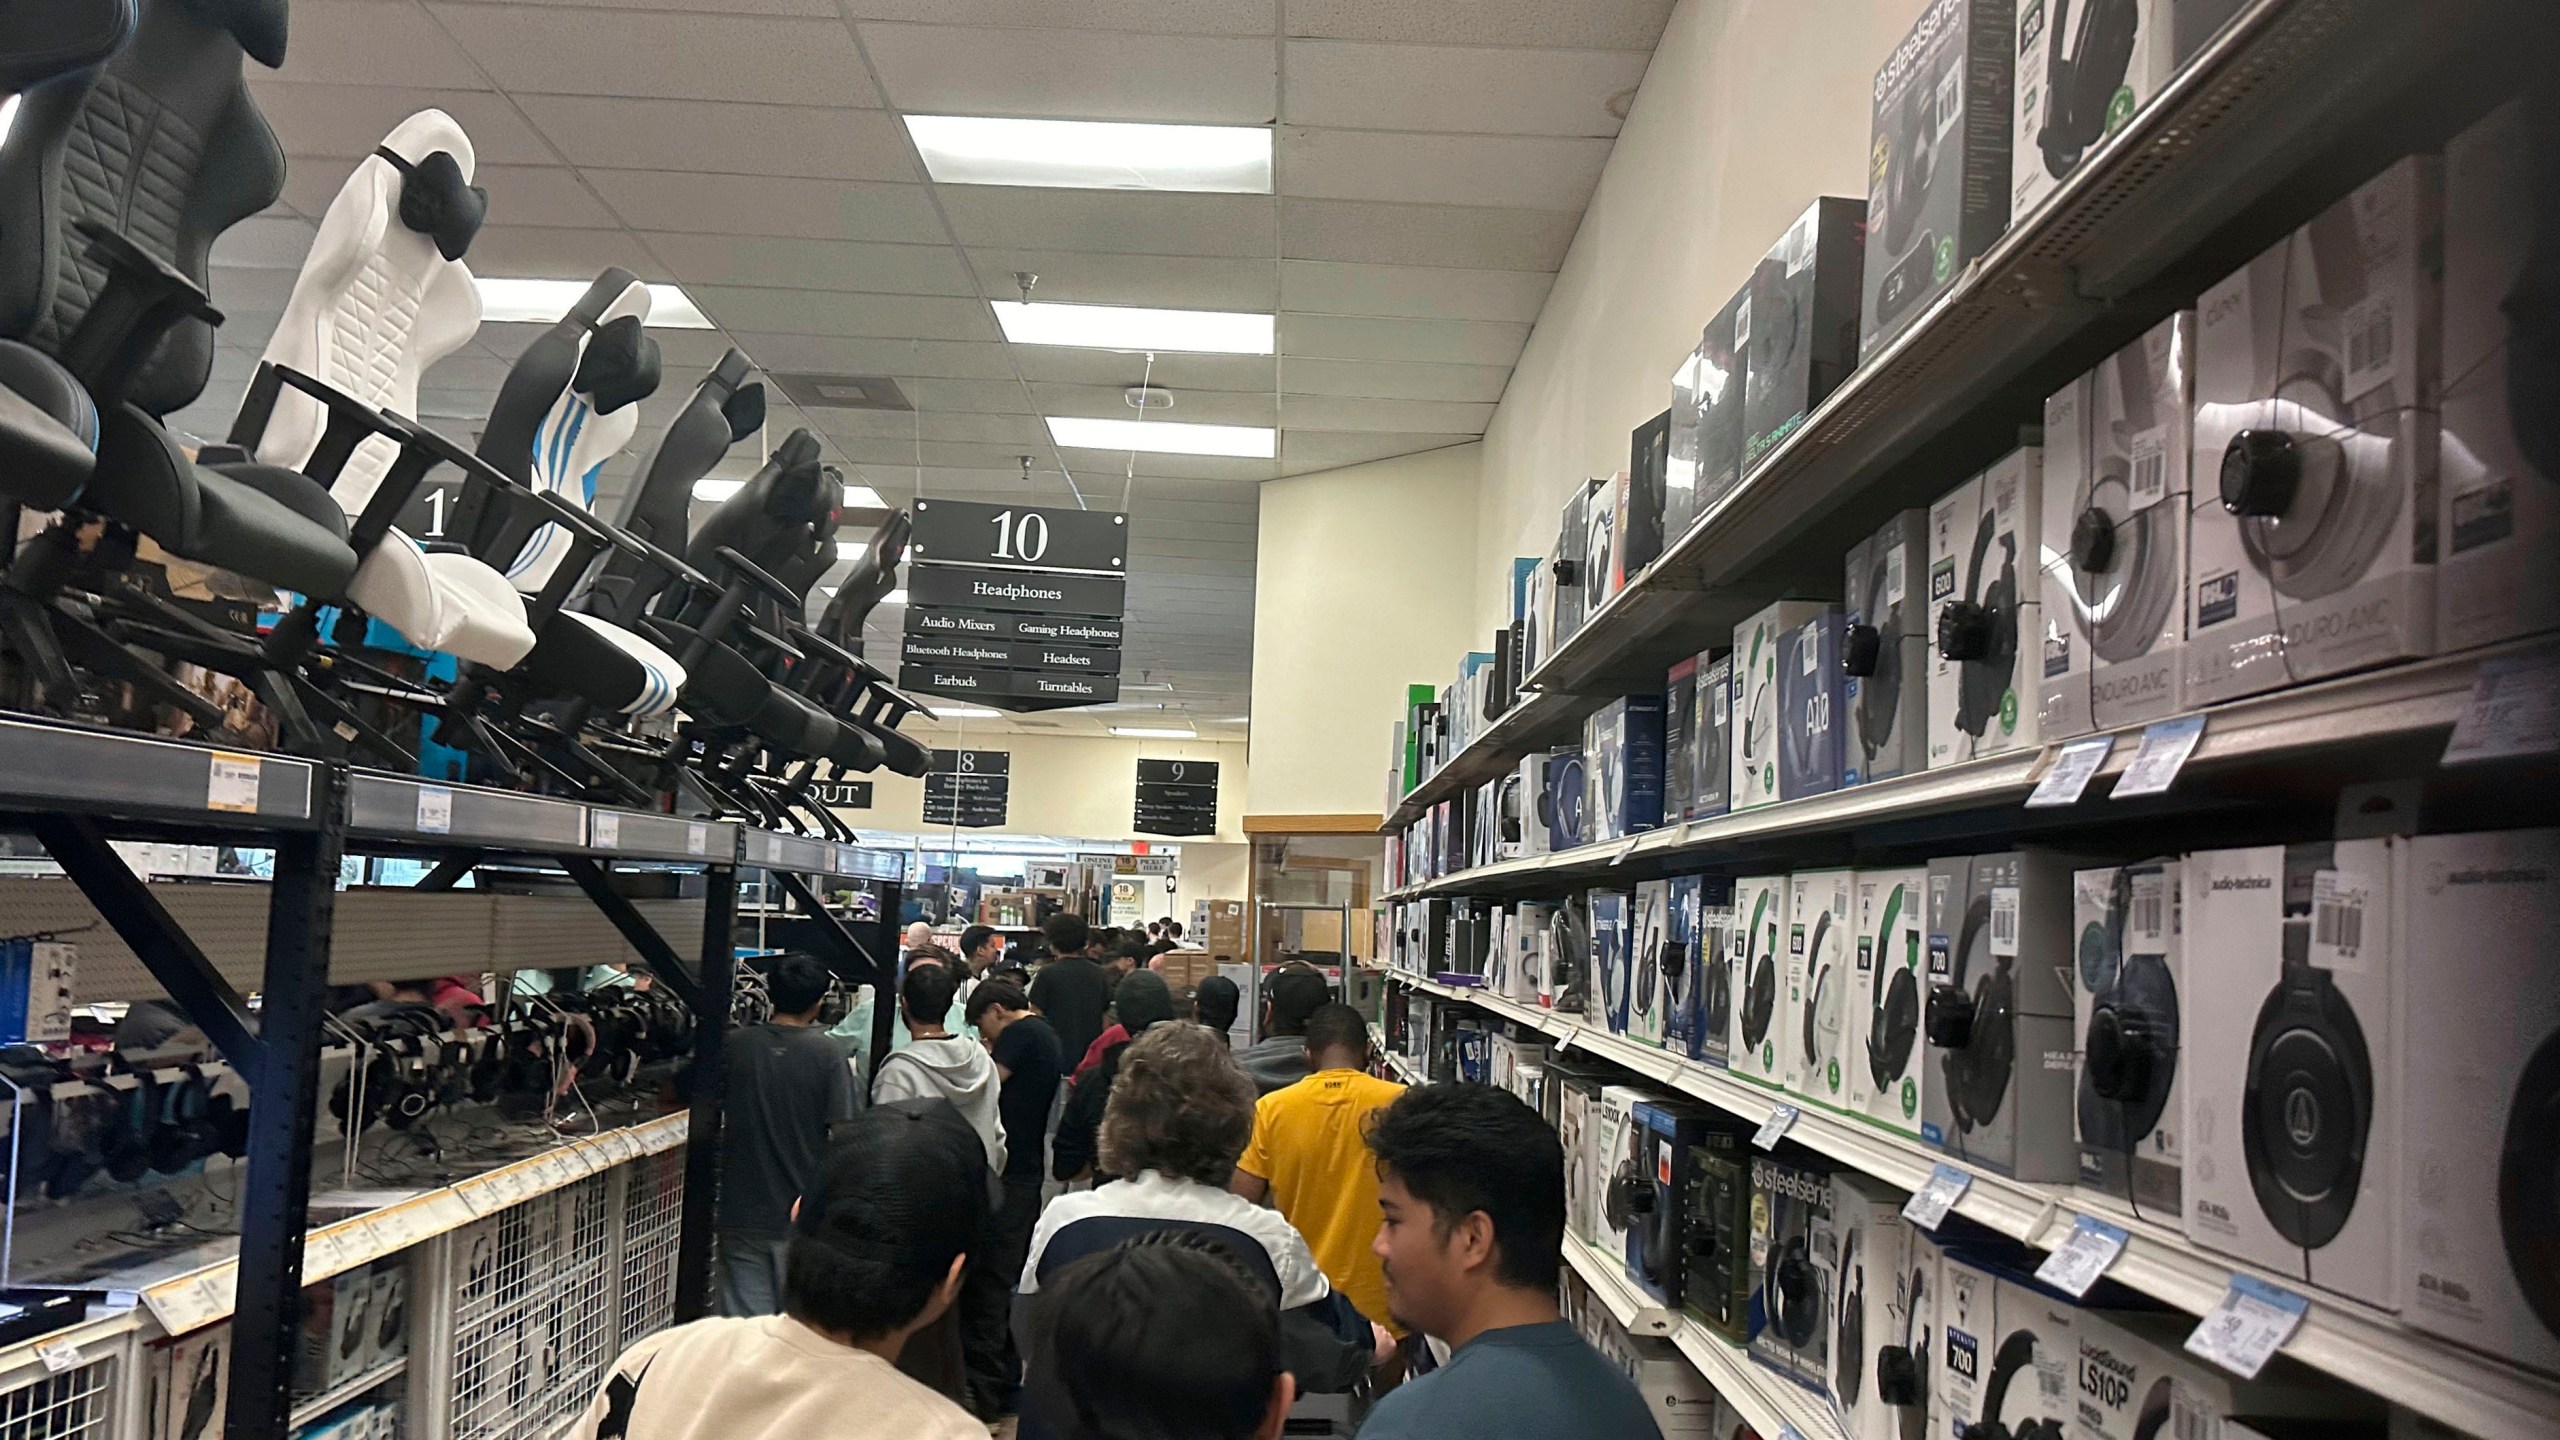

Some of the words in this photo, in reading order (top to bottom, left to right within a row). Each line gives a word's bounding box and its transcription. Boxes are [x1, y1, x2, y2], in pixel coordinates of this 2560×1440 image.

[424, 487, 459, 537] 1
[990, 510, 1049, 562] 10
[973, 581, 1062, 601] Headphones
[921, 615, 955, 630] Audio
[958, 618, 996, 632] Mixers
[1018, 622, 1057, 638] Gaming
[1060, 625, 1120, 640] Headphones
[906, 644, 951, 657] Bluetooth
[952, 646, 1008, 660] Headphones
[1043, 652, 1091, 667] Headsets
[934, 673, 977, 688] Earbuds
[1037, 680, 1093, 695] Turntables
[1806, 692, 1829, 737] A10
[961, 752, 975, 773] 8
[1171, 762, 1185, 782] 9
[1119, 884, 1129, 893] 18
[1166, 876, 1175, 891] 9
[1861, 949, 1868, 968] 70
[1932, 950, 1946, 971] 700
[1764, 1166, 1832, 1209] steelserie
[1949, 1327, 1976, 1350] STEALTH
[1952, 1344, 1972, 1375] 700
[2079, 1357, 2129, 1411] LS10P
